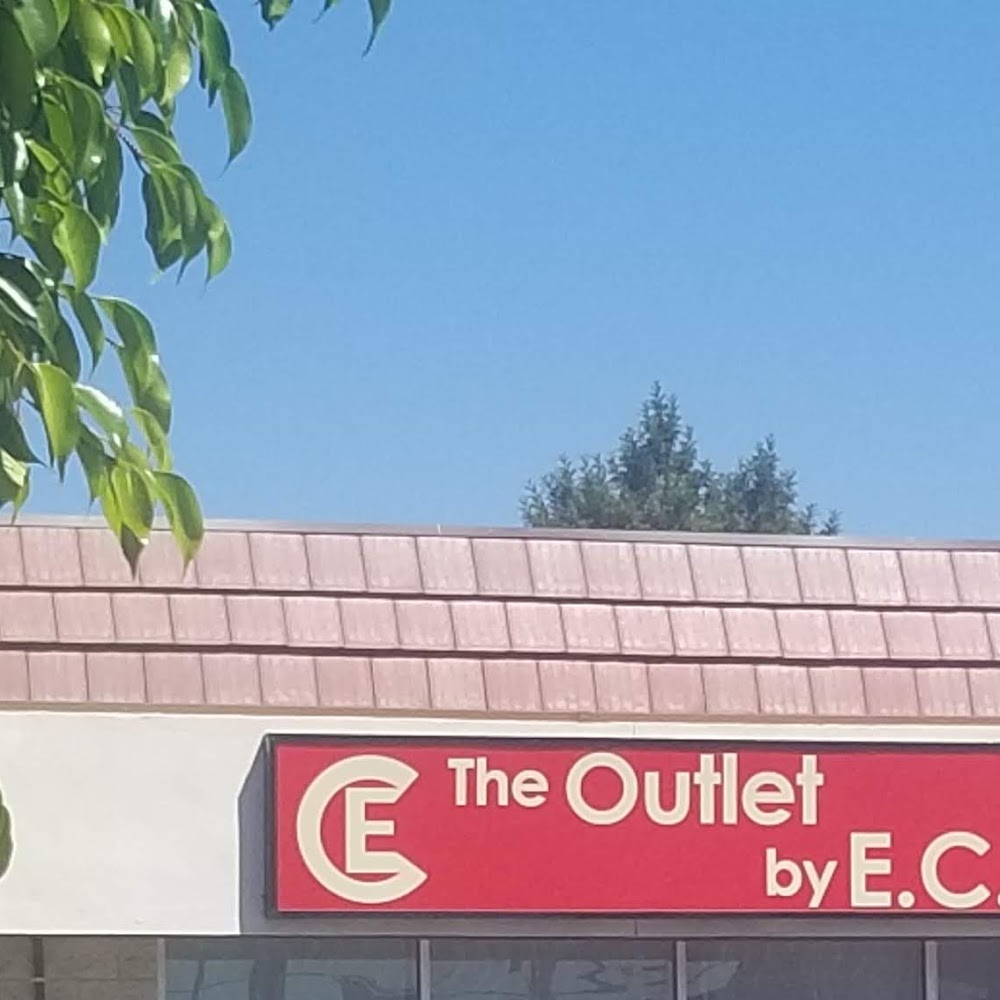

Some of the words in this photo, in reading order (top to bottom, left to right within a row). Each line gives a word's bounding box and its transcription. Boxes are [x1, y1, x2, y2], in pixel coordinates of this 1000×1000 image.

[447, 757, 549, 808] The
[565, 752, 825, 826] Outlet
[765, 847, 839, 909] by
